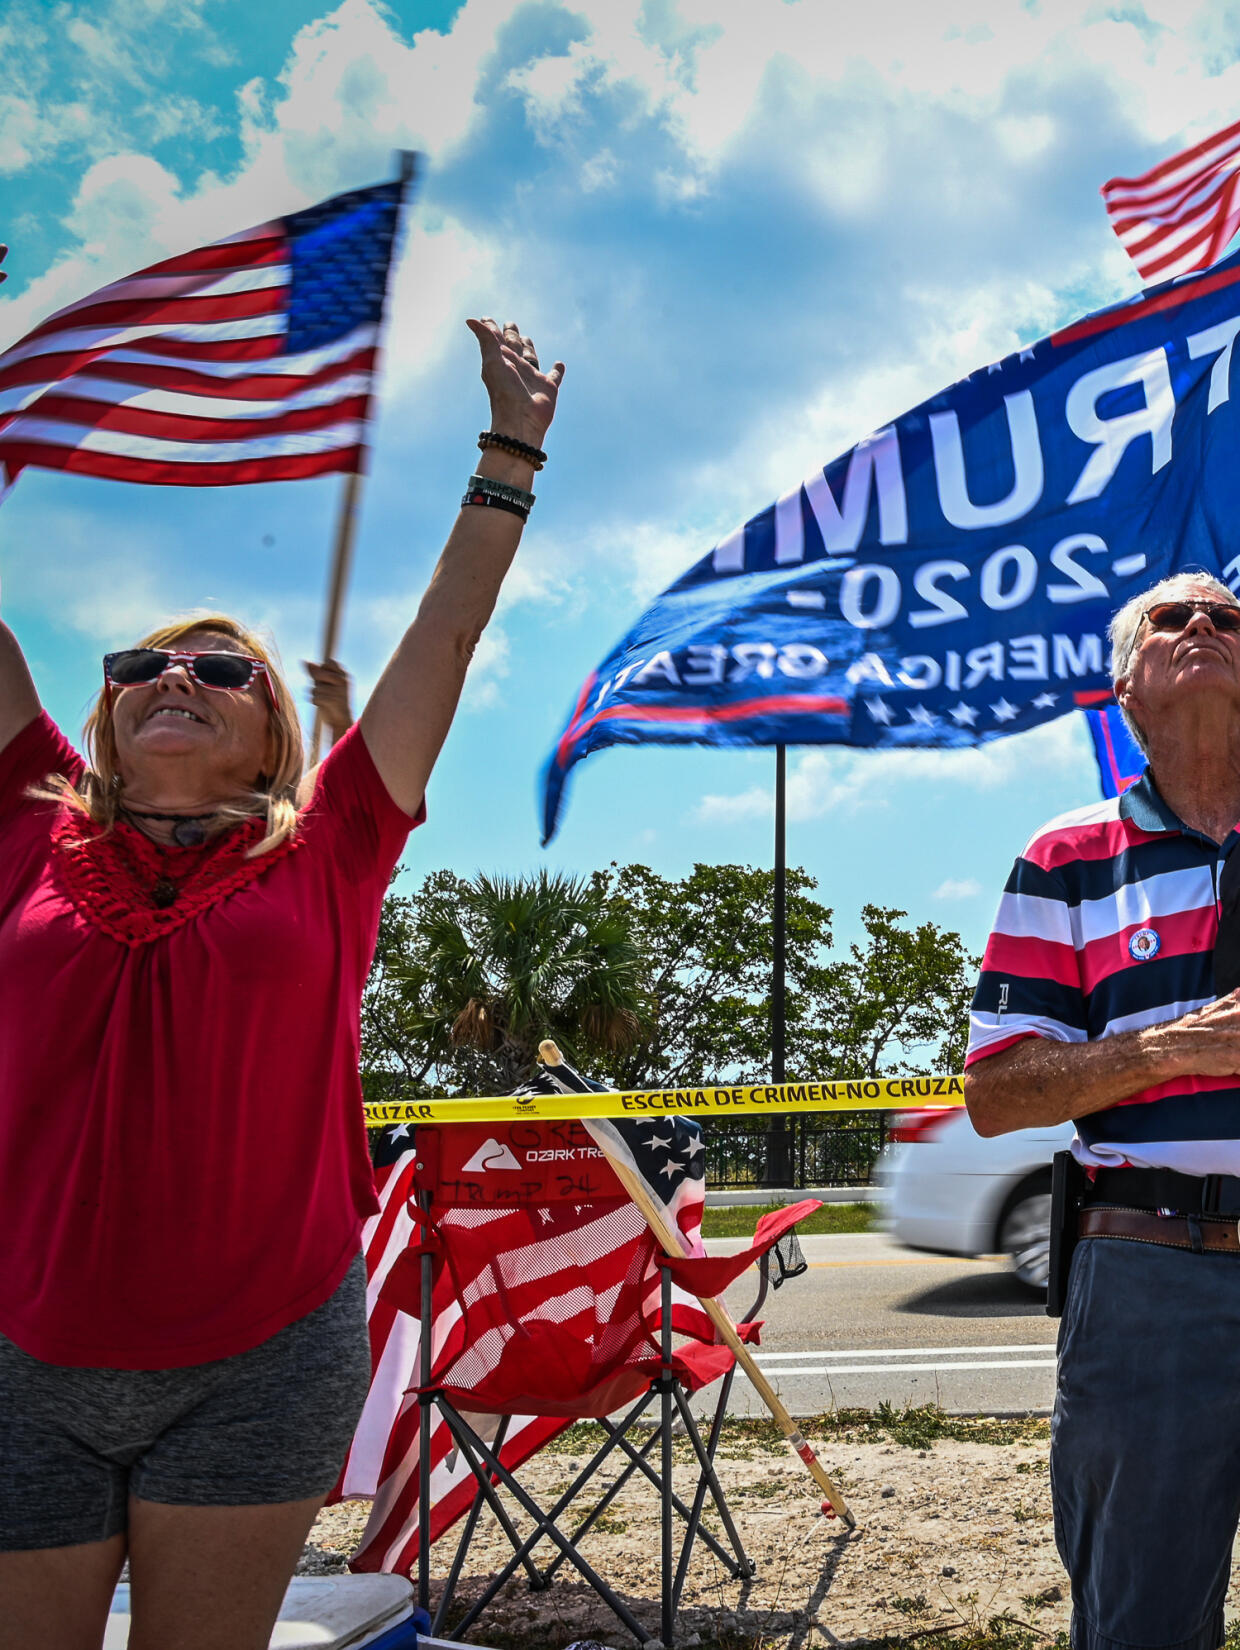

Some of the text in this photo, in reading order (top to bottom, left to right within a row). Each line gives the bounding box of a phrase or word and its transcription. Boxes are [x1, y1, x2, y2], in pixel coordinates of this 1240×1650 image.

[621, 1077, 965, 1110] ESCENA DE CRIMEN-NO CRUZA
[363, 1104, 435, 1120] RUZAR
[526, 1148, 576, 1163] OZARK
[556, 1173, 600, 1198] 24
